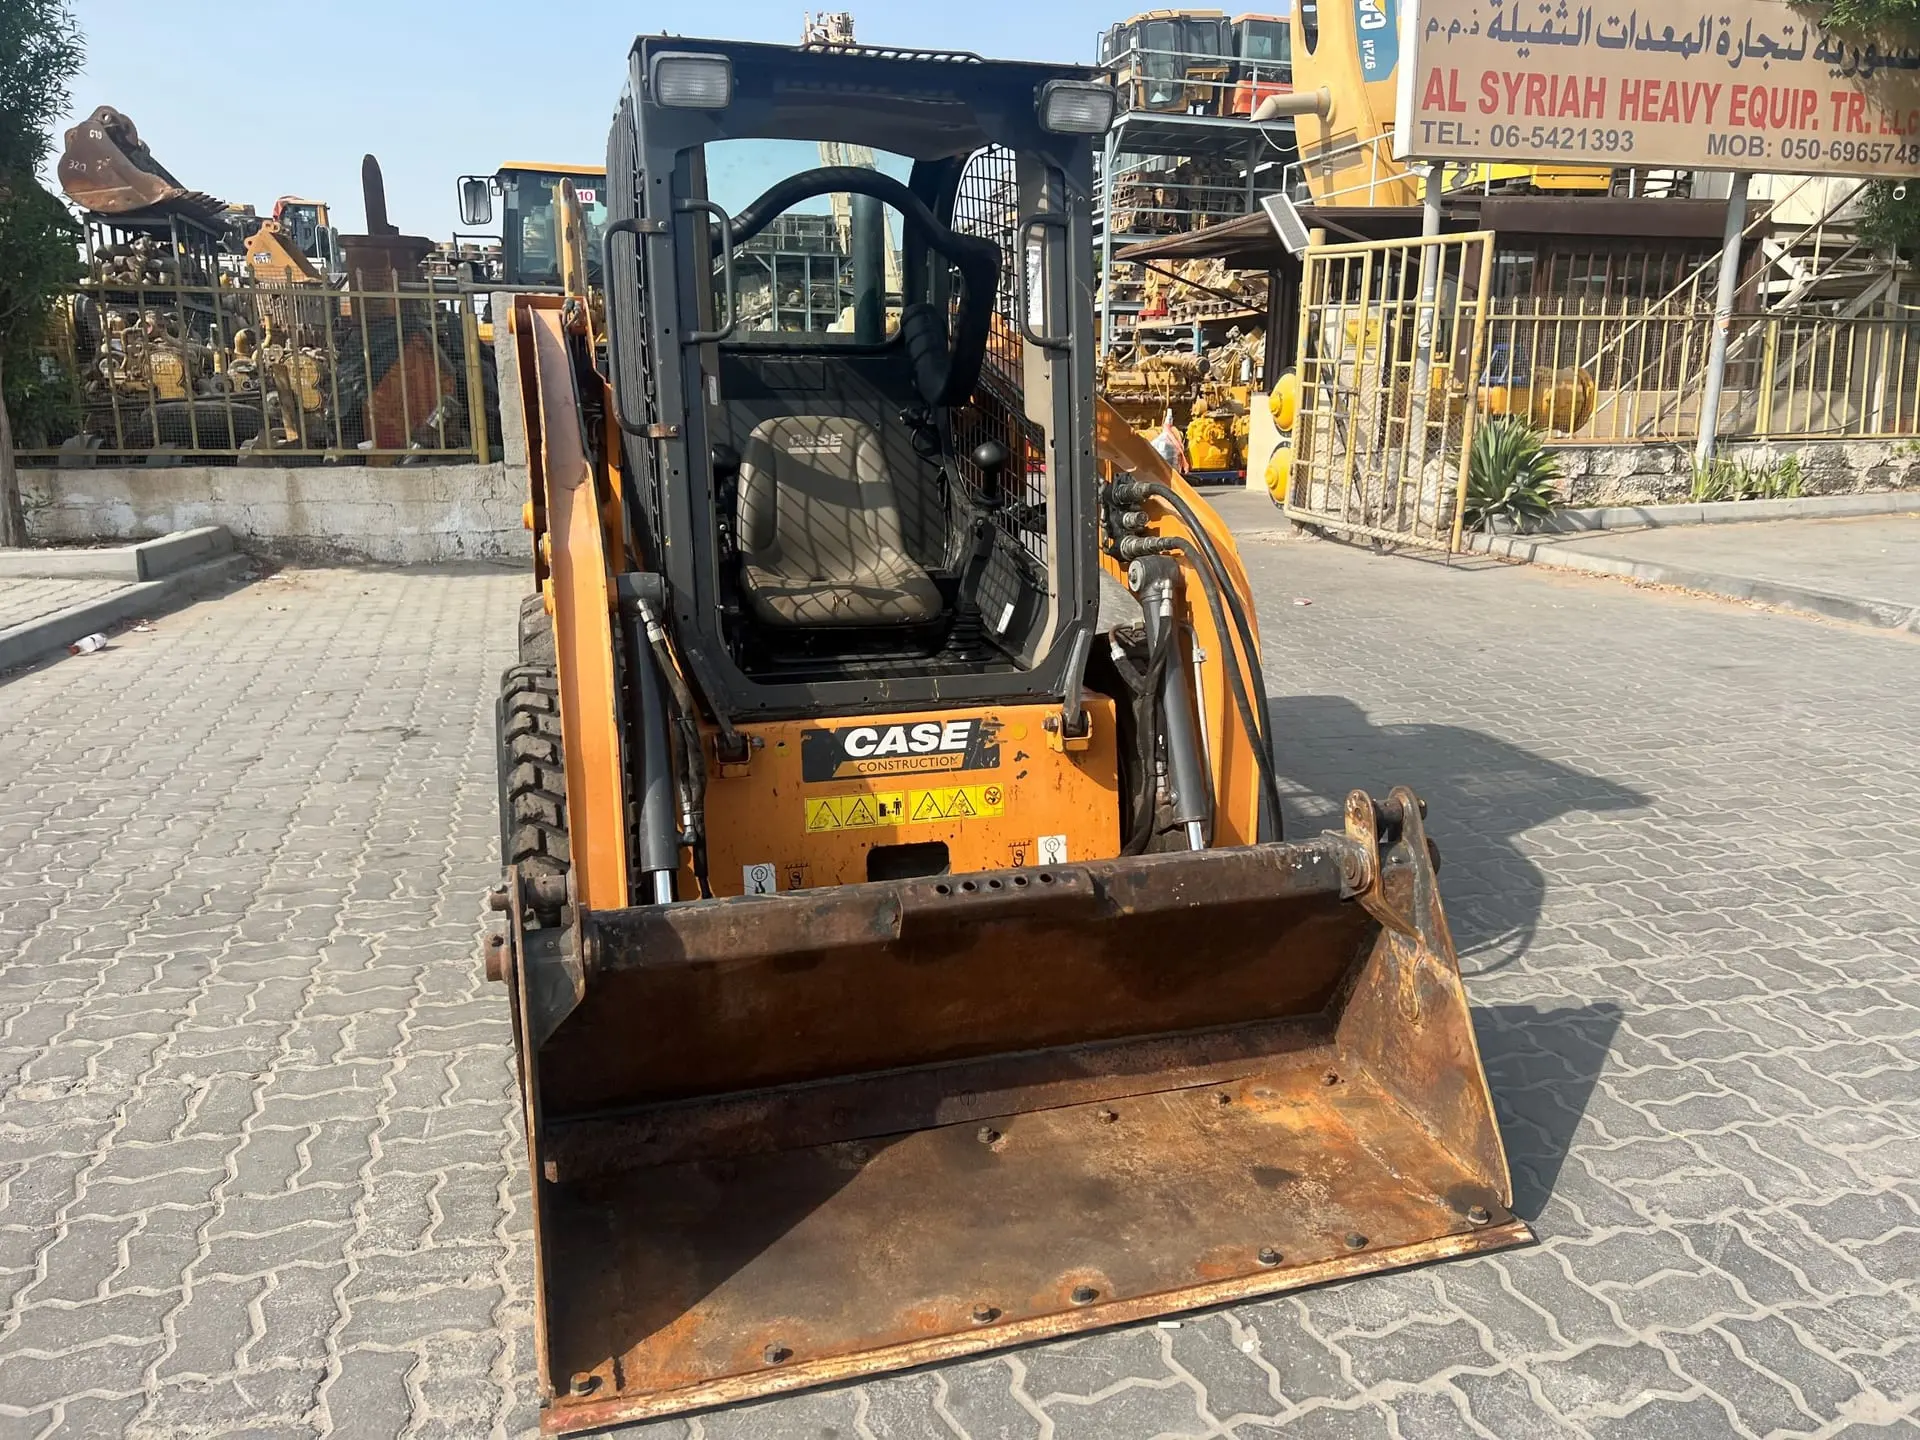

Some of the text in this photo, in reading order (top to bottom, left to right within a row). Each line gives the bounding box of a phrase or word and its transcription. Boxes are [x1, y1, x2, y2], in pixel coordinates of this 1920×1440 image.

[1486, 0, 1592, 59] الثقيلة
[1596, 10, 1713, 60] المعدات
[1715, 16, 1809, 70] لتجارة
[1362, 39, 1377, 70] 972H
[1423, 69, 1466, 112] AL
[1479, 71, 1606, 118] SYRIAH
[1620, 80, 1722, 125] HEAVY
[1729, 85, 1818, 129] EQUIP.
[1831, 92, 1871, 133] TR.
[1420, 120, 1634, 152] TEL: 06-5421393
[1707, 133, 1920, 165] MOB: 050-6965748
[843, 720, 972, 758] CASE
[857, 754, 961, 774] CONSTRUCTION
